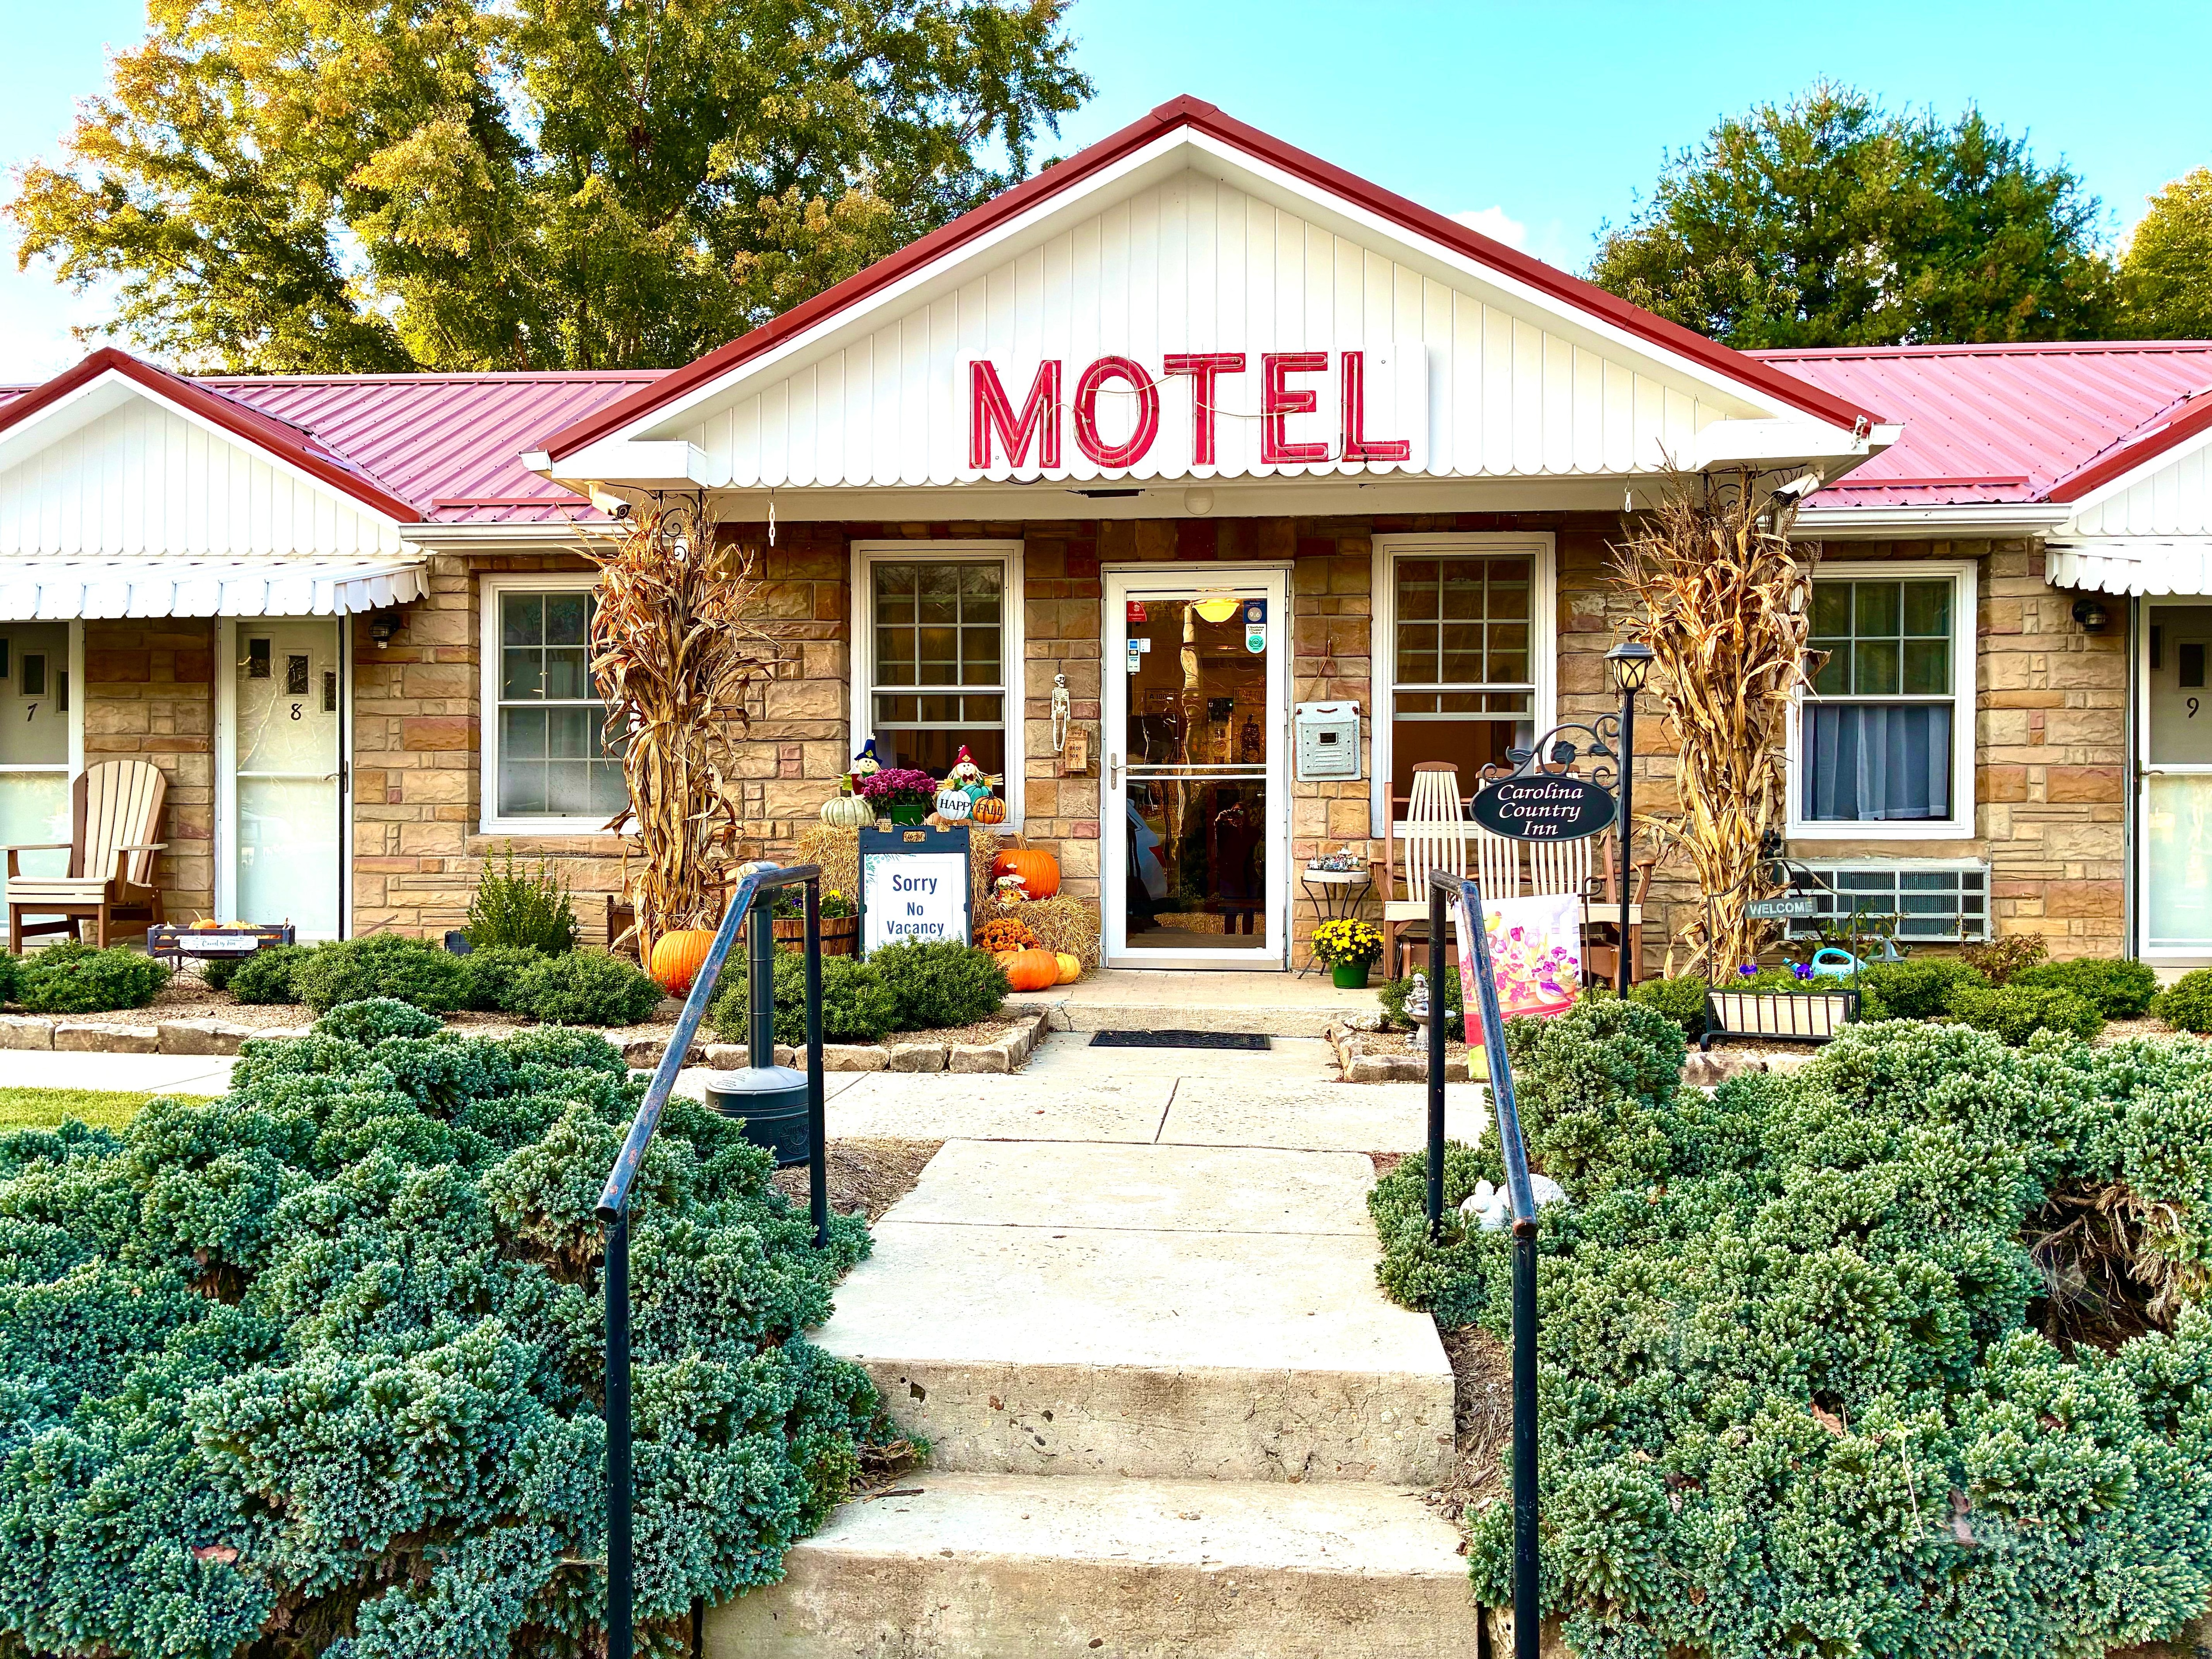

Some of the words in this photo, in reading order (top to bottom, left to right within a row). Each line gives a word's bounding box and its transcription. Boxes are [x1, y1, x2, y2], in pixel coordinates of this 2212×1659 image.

[969, 352, 1409, 469] MOTEL
[27, 703, 38, 722] 7
[291, 703, 303, 721] 8
[2187, 697, 2199, 718] 9
[1497, 782, 1584, 801] Carolina
[940, 799, 975, 811] HAPPY
[977, 803, 1004, 816] FALL
[1499, 802, 1581, 822] Country
[1521, 821, 1559, 836] Inn
[893, 874, 937, 895] Sorry
[907, 902, 924, 916] No
[1749, 901, 1813, 915] WELCOME
[887, 921, 944, 937] Vacancy
